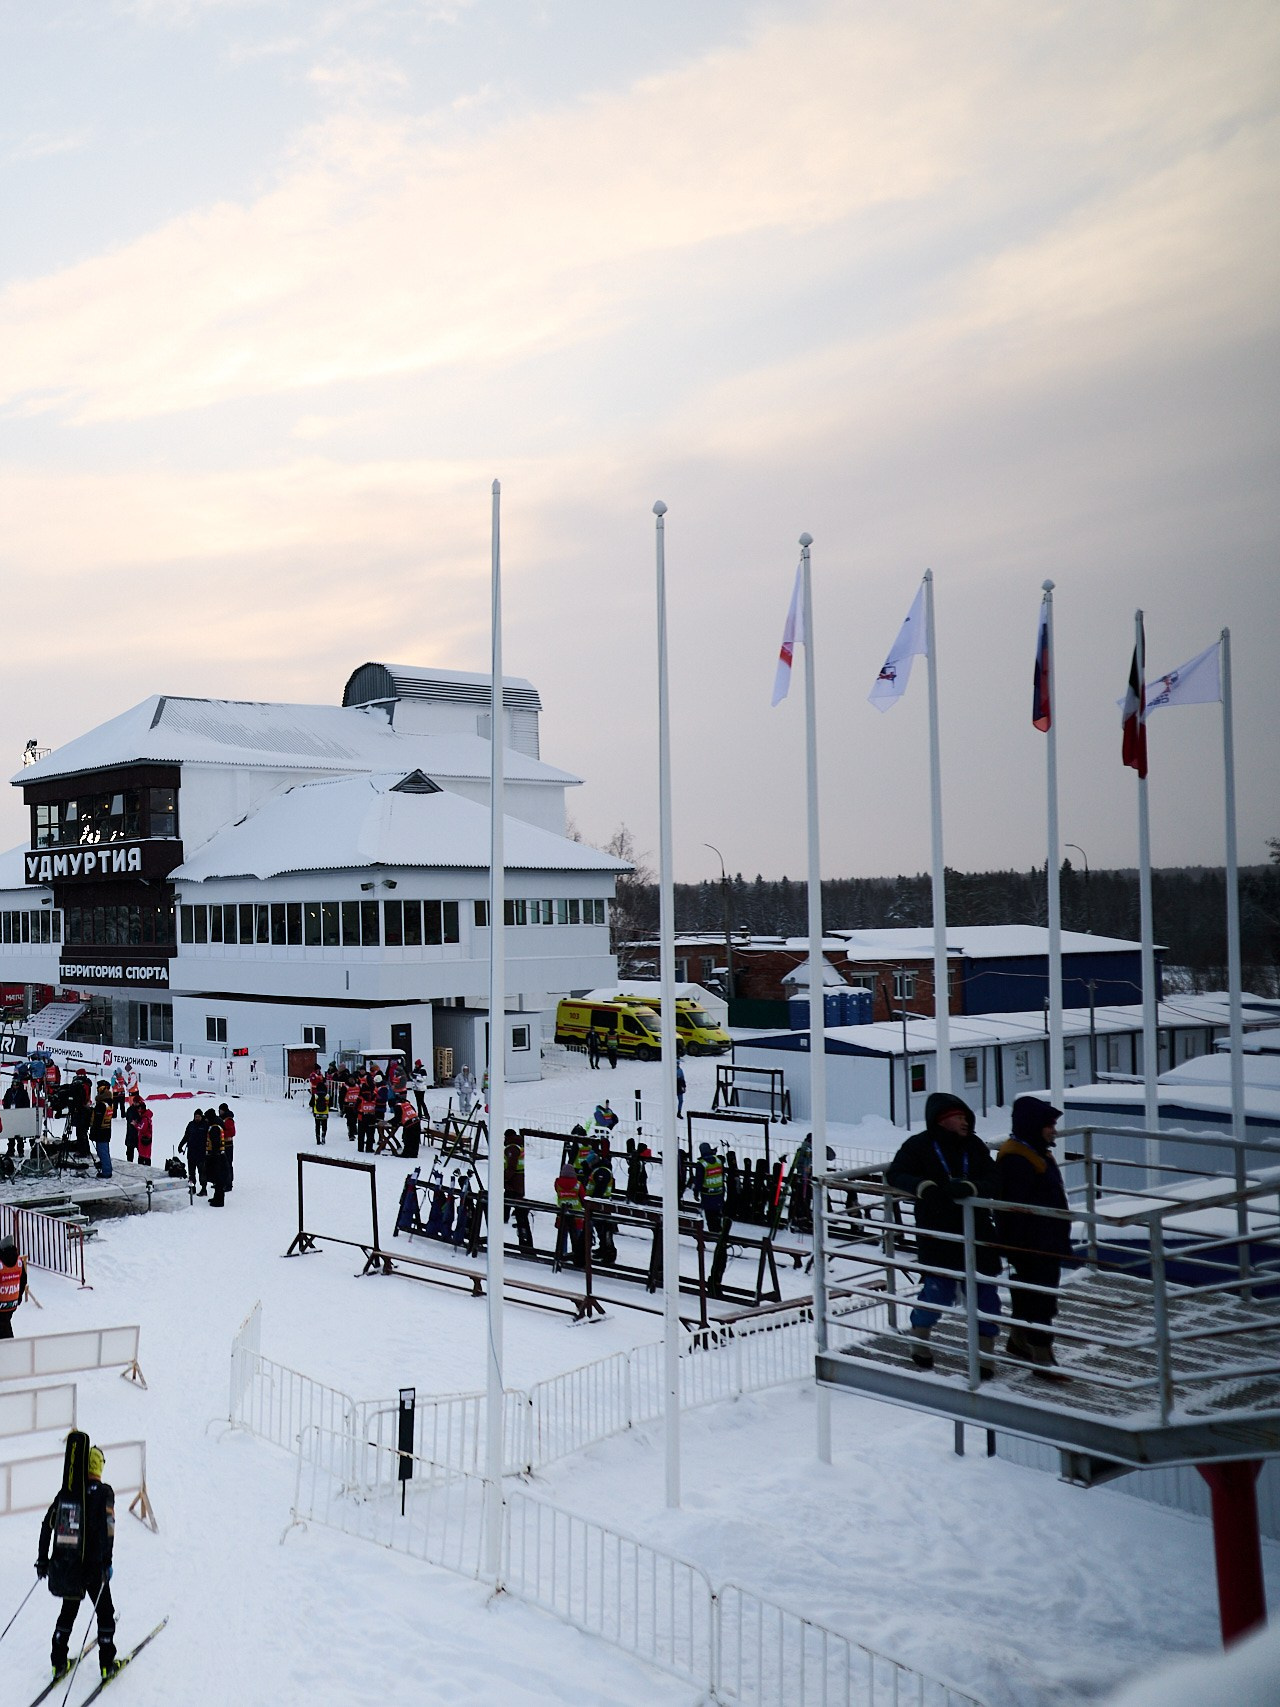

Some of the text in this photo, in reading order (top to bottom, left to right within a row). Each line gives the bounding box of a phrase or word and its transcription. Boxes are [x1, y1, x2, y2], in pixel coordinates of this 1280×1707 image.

[26, 847, 142, 882] УДМУРТИЯ
[59, 964, 169, 981] ТЕРРИТОРИЯ СПОРТА
